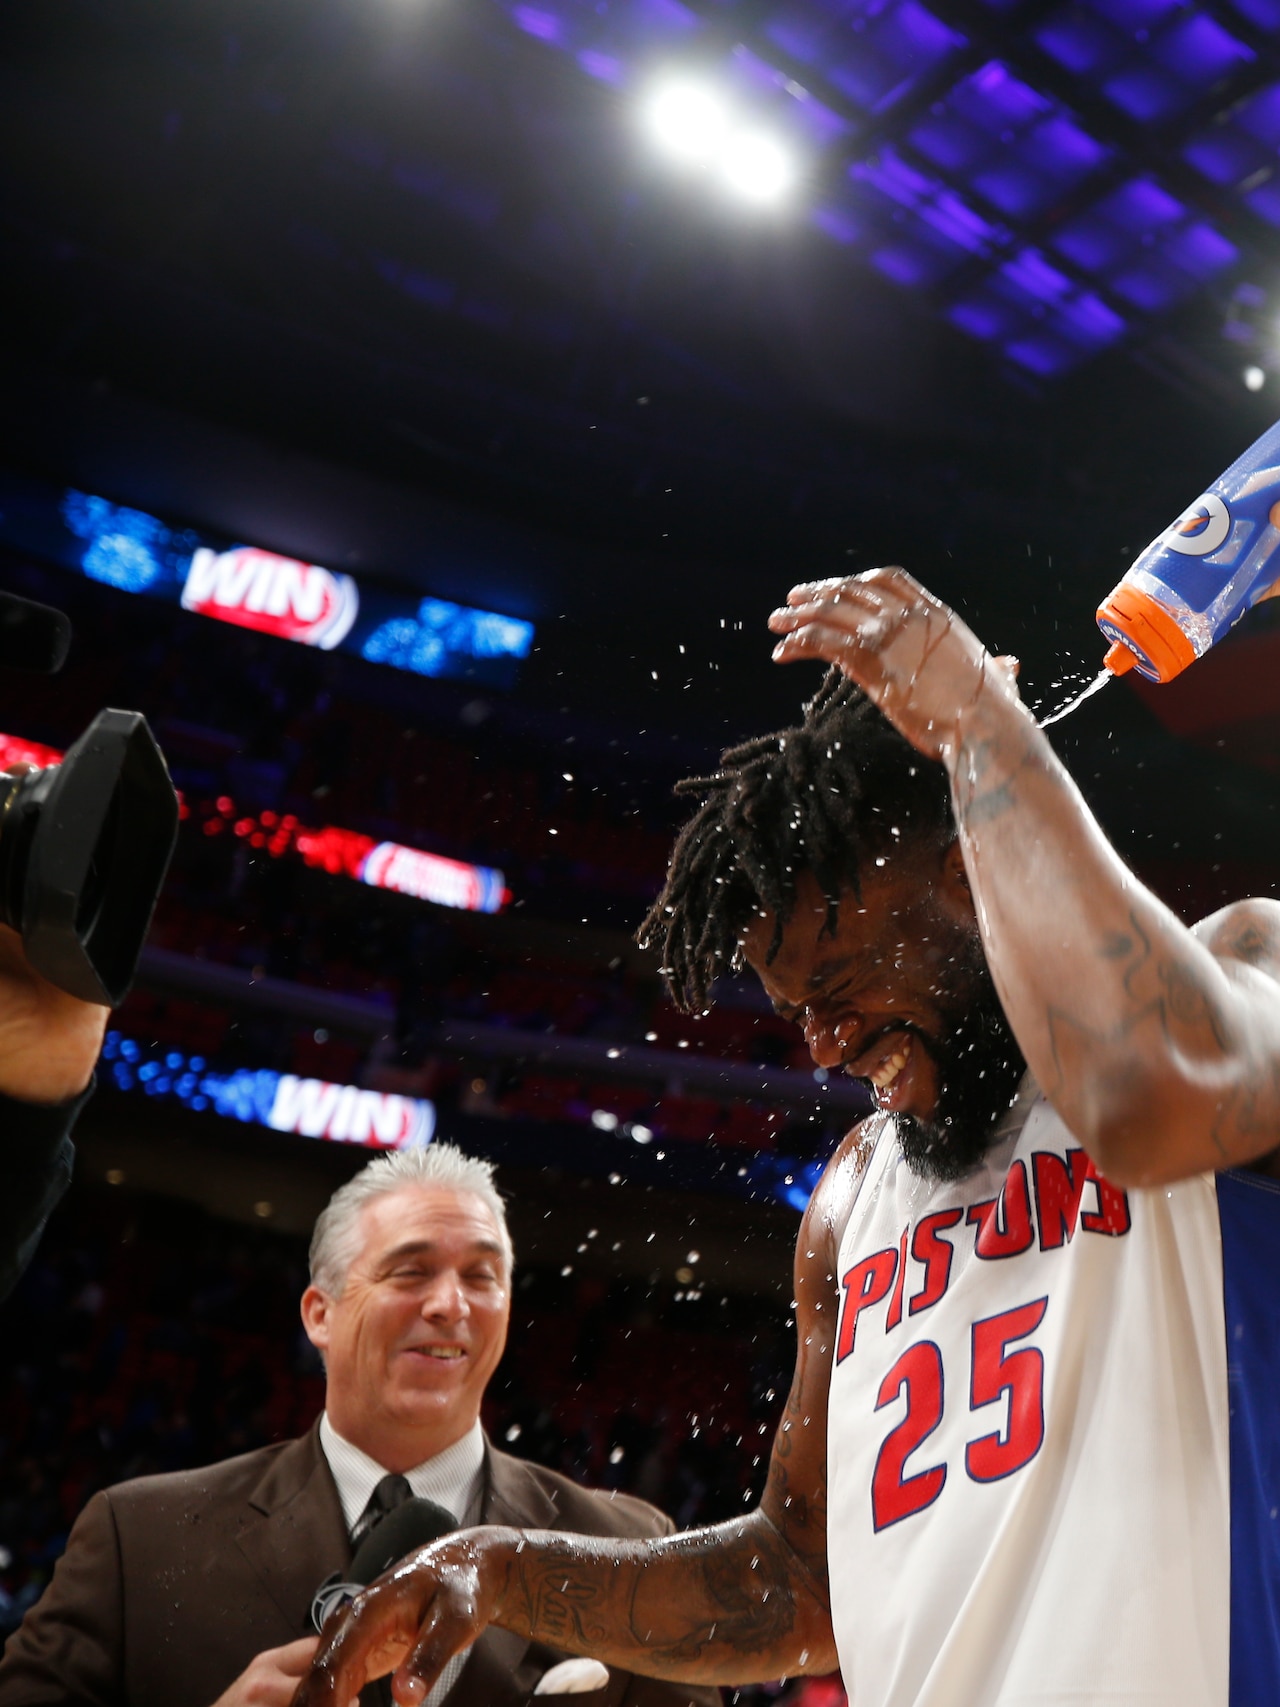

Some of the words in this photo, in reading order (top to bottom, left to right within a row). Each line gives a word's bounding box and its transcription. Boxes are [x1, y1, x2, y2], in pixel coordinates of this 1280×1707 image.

[185, 547, 327, 622] WIN
[271, 1074, 402, 1144] WIN
[871, 1295, 1048, 1534] 25
